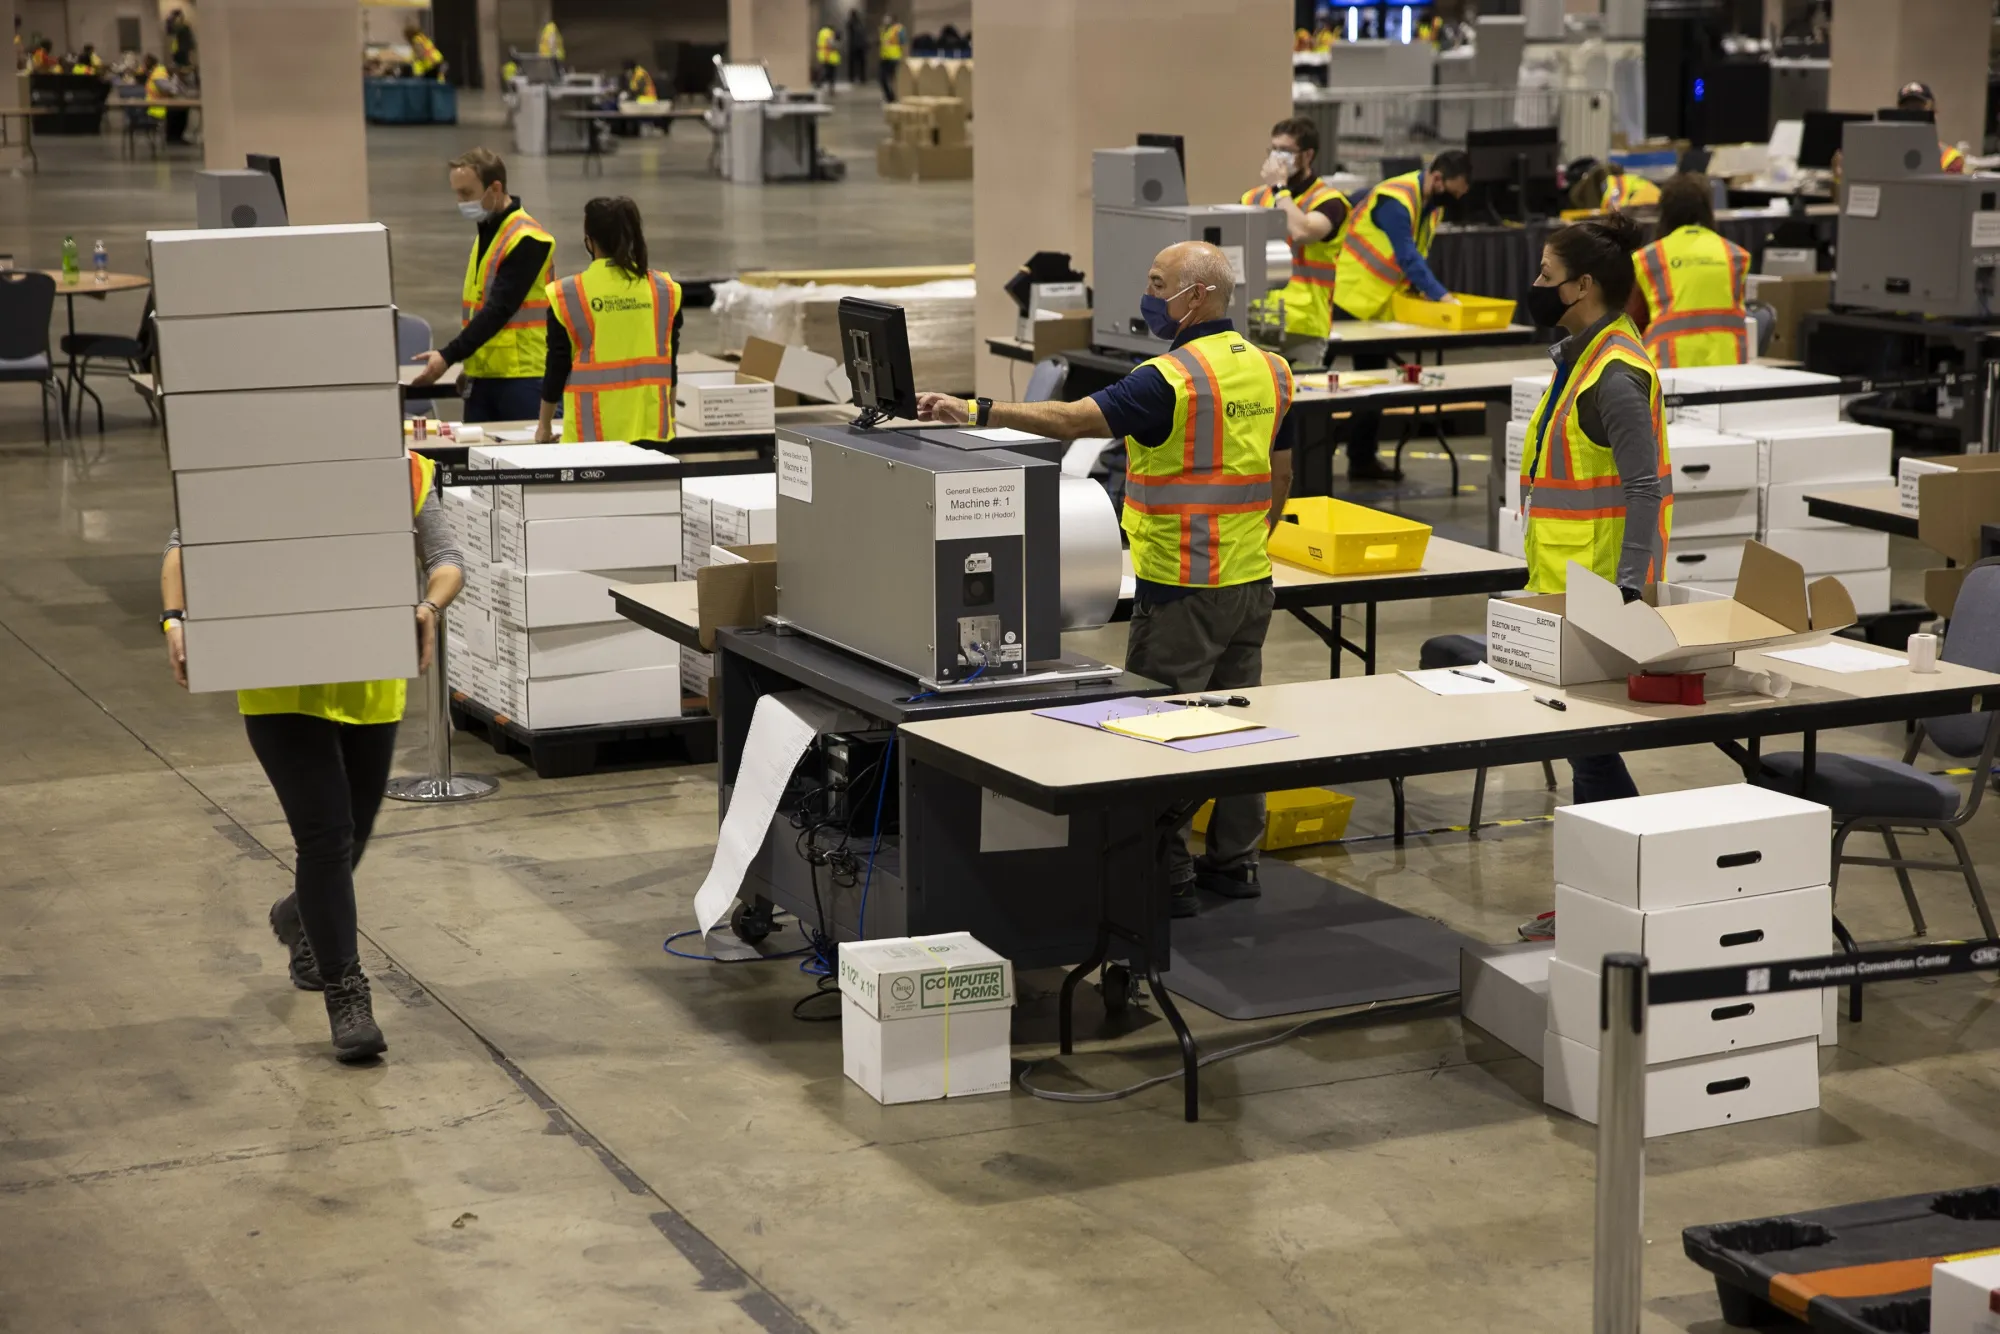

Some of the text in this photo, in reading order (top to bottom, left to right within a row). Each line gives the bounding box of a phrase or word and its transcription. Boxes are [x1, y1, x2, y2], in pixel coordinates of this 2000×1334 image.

[946, 484, 1016, 496] General Election 2020
[950, 498, 990, 510] Machine
[1004, 496, 1010, 506] 1
[946, 513, 972, 522] Machine
[992, 511, 1016, 520] (Hodor)
[1492, 620, 1521, 633] ELECTION DATE
[1536, 617, 1556, 628] ELECTION
[1492, 644, 1504, 652] WARD
[1511, 648, 1530, 658] PRECINCT
[1492, 655, 1508, 664] NUMBER
[1514, 660, 1532, 671] BALLOTS
[841, 960, 846, 976] 9
[1789, 964, 1857, 982] Pennsylvania
[1857, 958, 1915, 973] Convention
[1916, 954, 1952, 967] Center
[924, 971, 1000, 991] COMPUTER
[952, 984, 1000, 1001] FORMS
